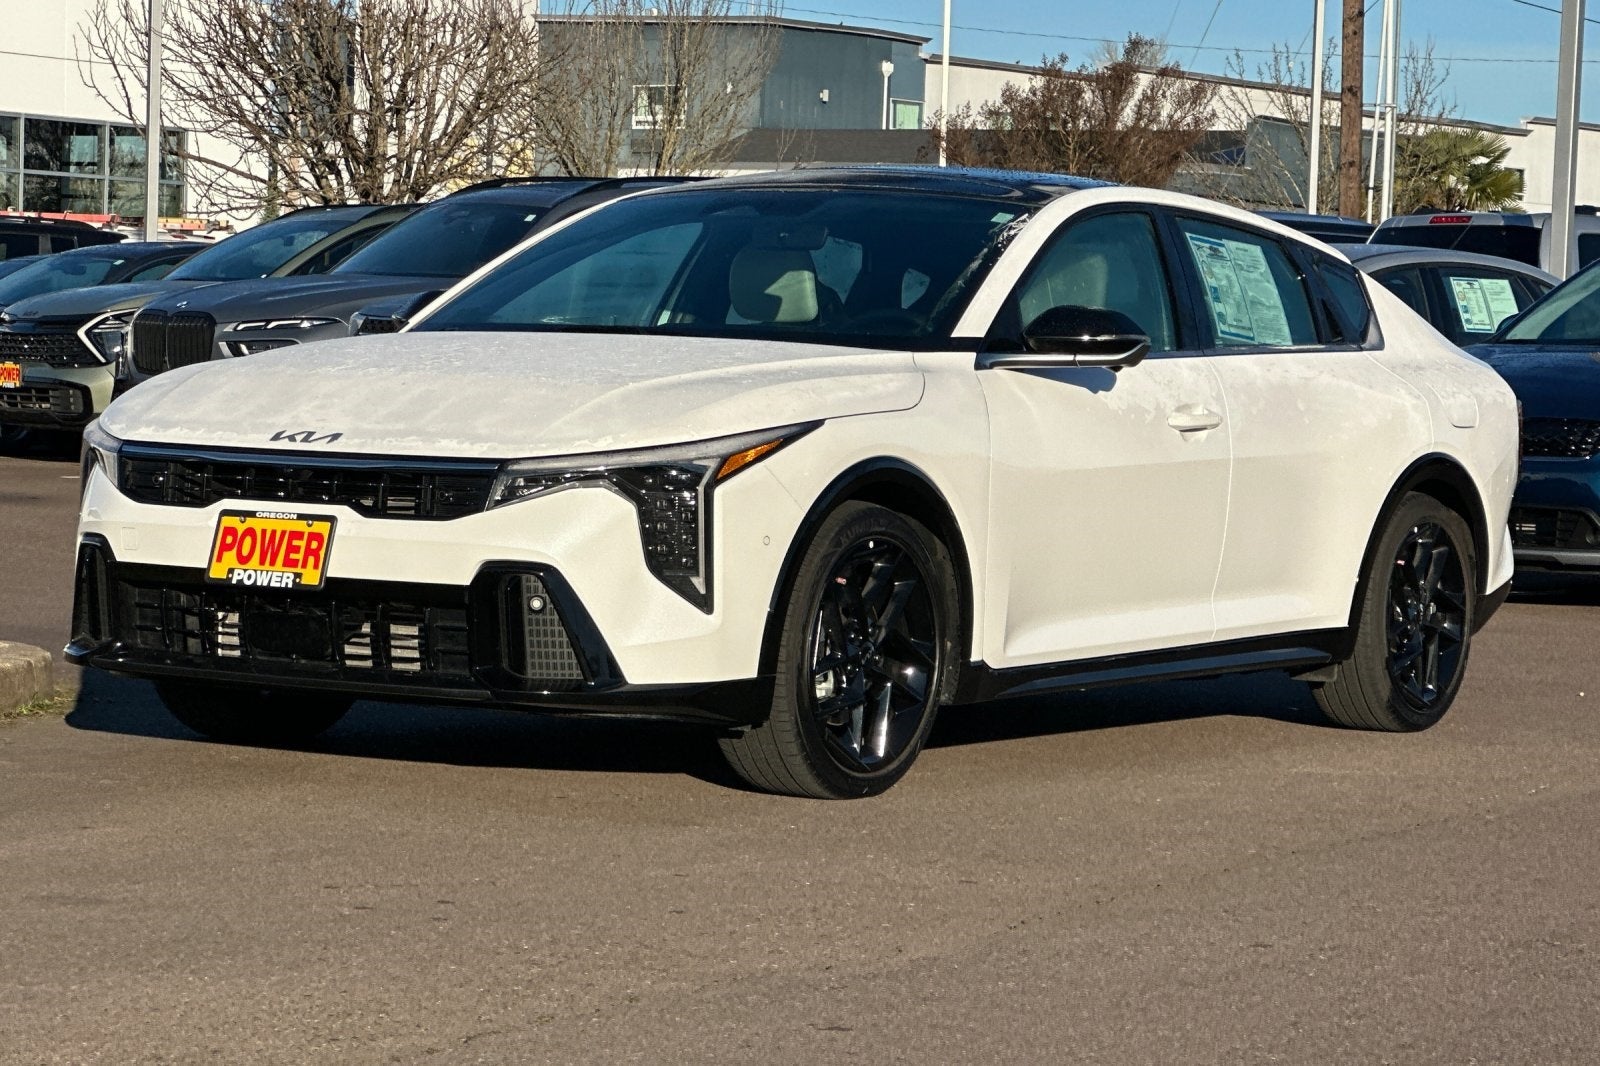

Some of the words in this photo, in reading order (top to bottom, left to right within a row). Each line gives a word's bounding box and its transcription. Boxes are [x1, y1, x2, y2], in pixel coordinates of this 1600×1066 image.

[255, 511, 297, 520] OREGON
[216, 526, 325, 570] POWER
[231, 569, 294, 588] POWER
